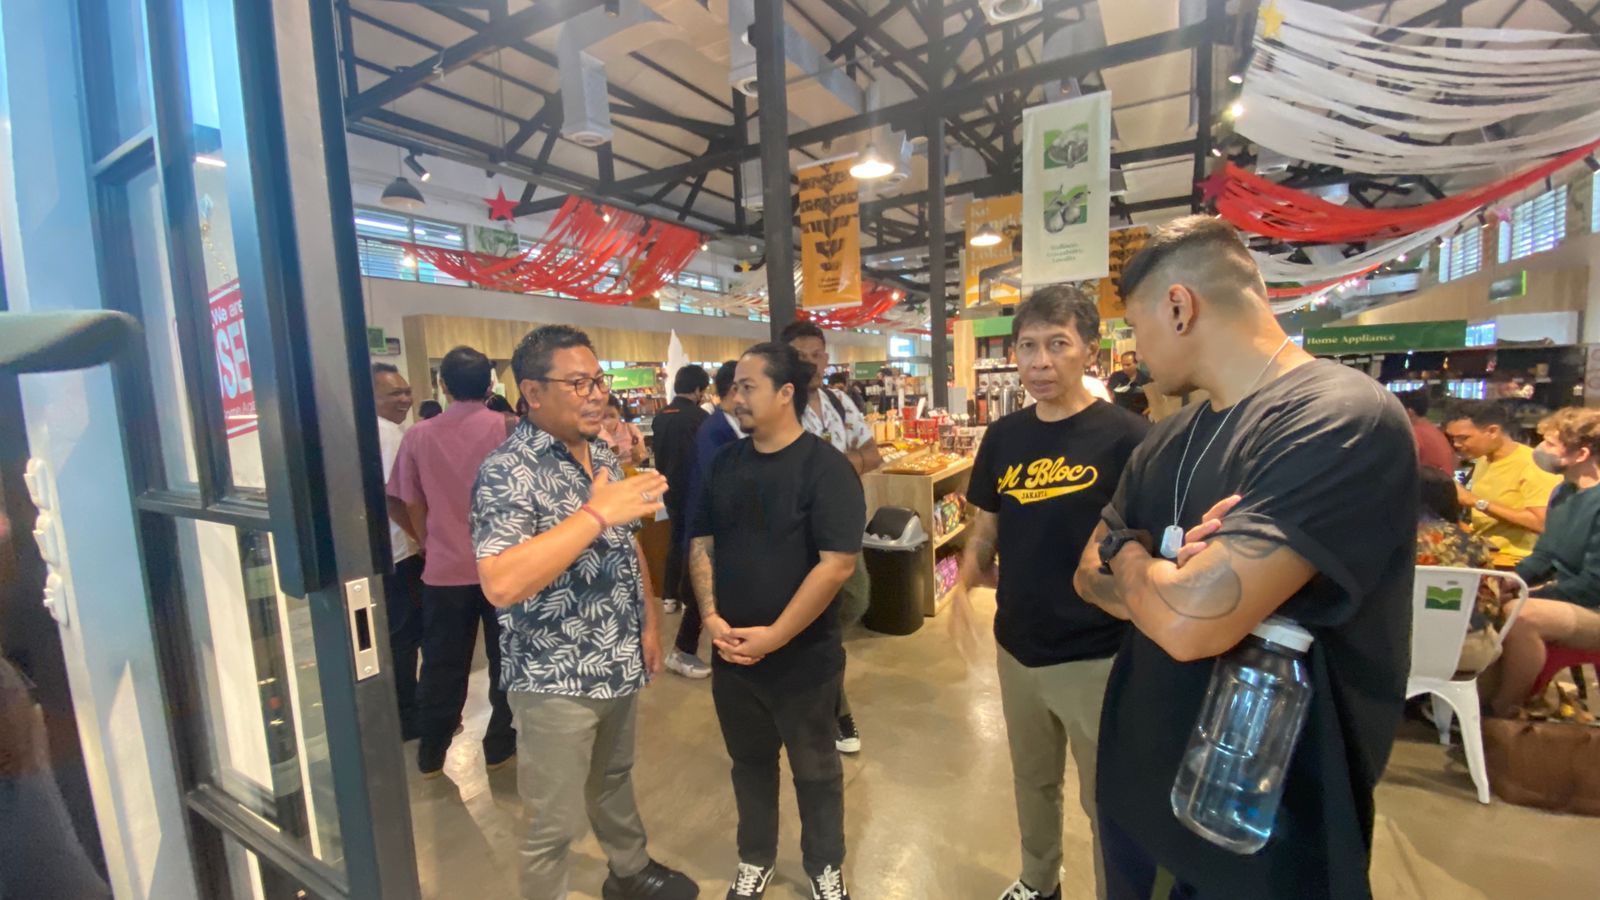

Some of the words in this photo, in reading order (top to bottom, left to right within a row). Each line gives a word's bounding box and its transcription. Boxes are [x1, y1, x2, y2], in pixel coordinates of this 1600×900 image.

[1307, 337, 1338, 345] Home
[1343, 334, 1396, 345] Appliance
[1024, 456, 1092, 489] Bloc
[1021, 490, 1048, 500] JAKARTA
